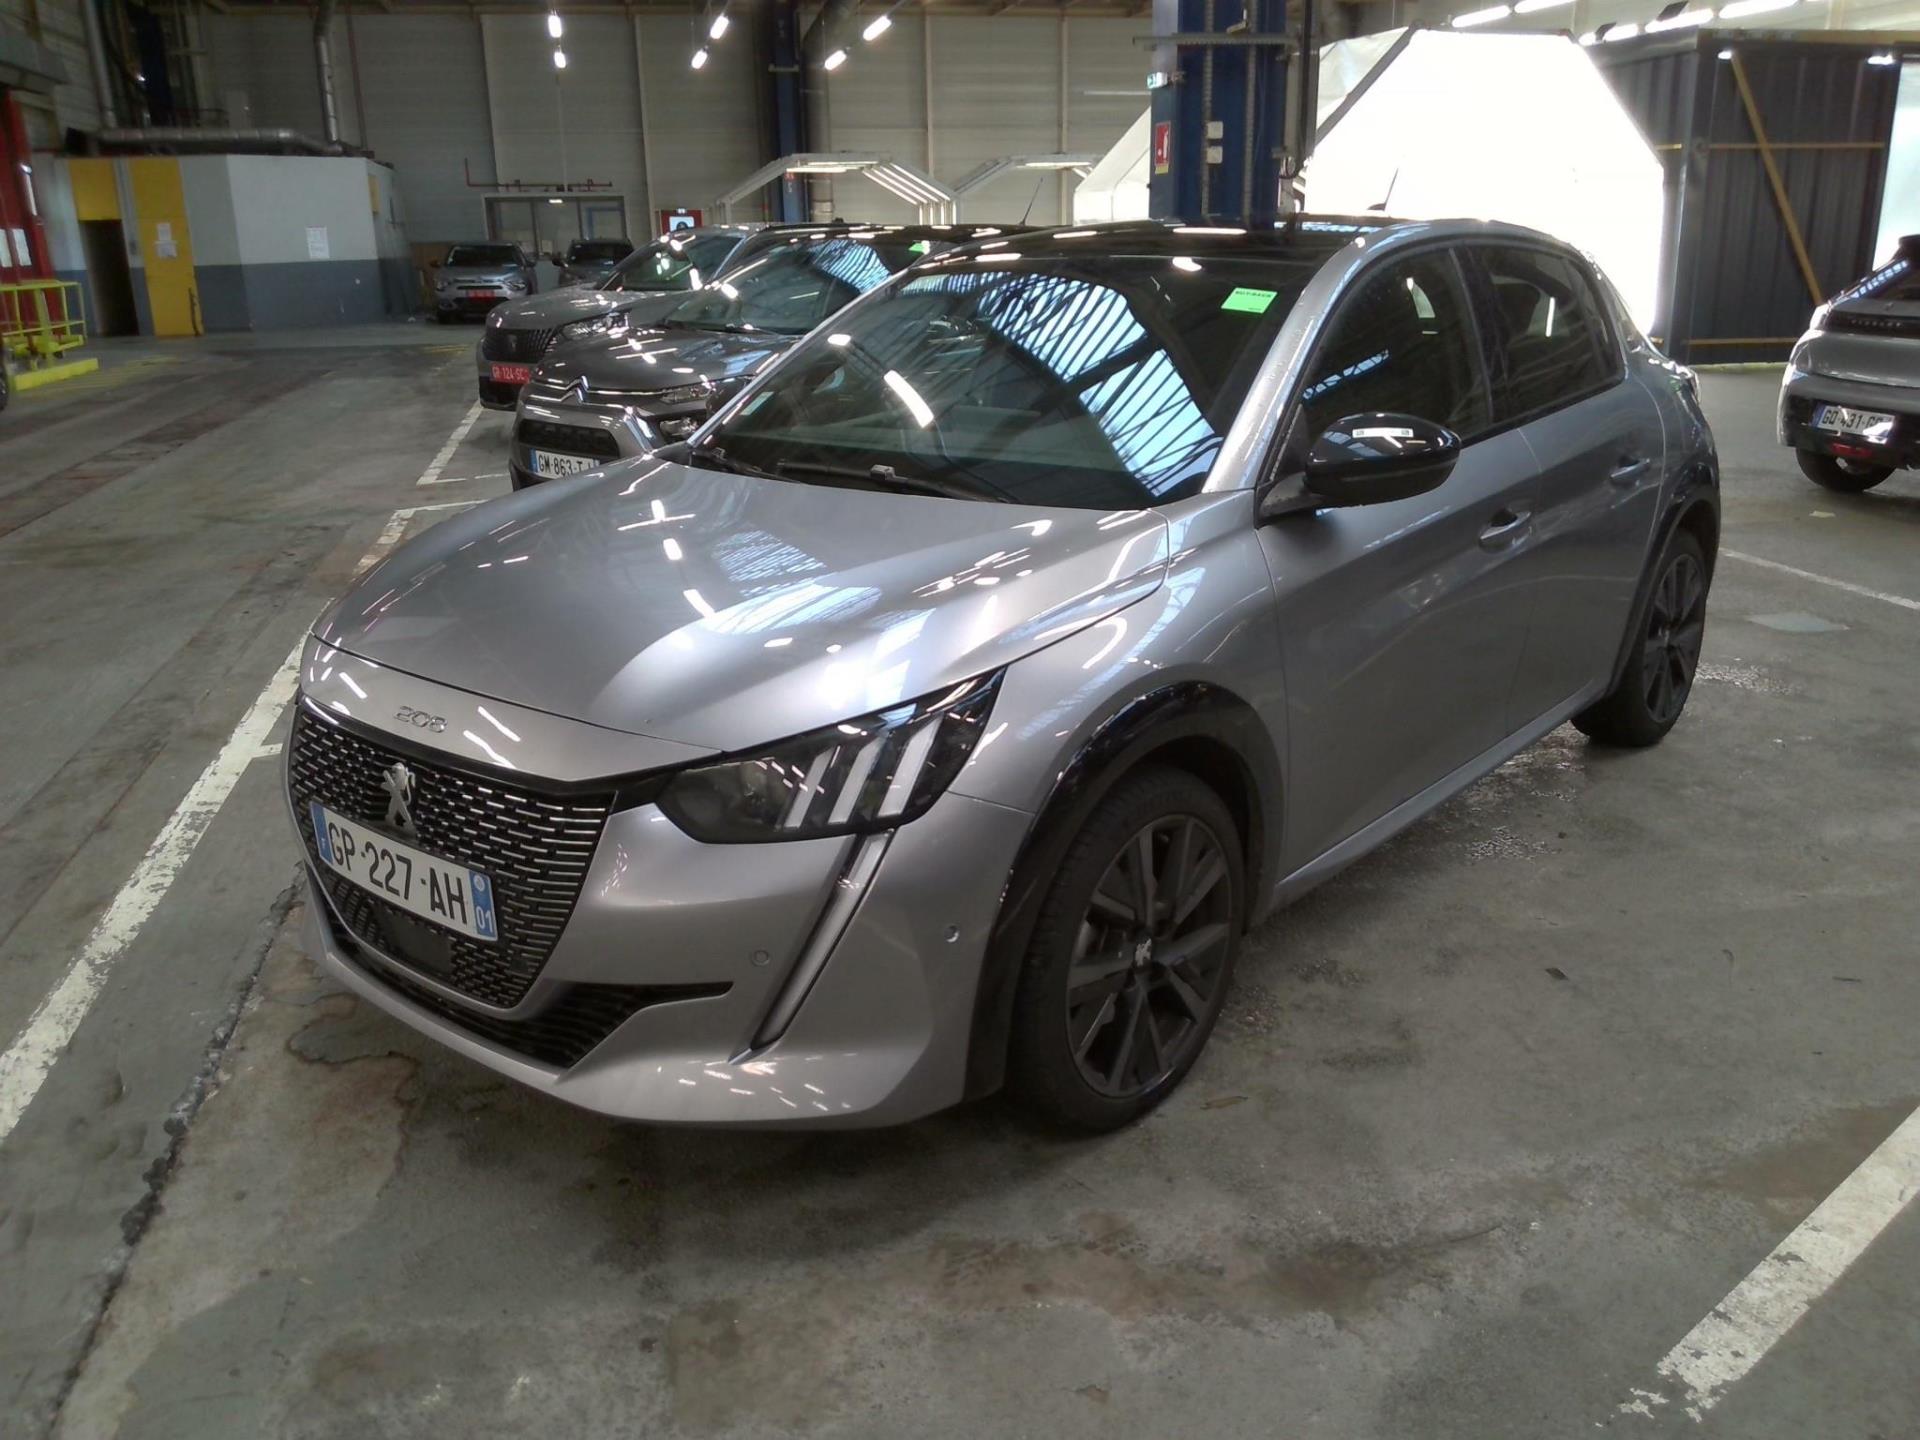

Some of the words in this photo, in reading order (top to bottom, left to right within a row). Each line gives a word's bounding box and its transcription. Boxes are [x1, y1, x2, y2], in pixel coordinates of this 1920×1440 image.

[393, 705, 448, 733] 208
[327, 821, 468, 925] GP-227-AH
[476, 905, 494, 933] 01
